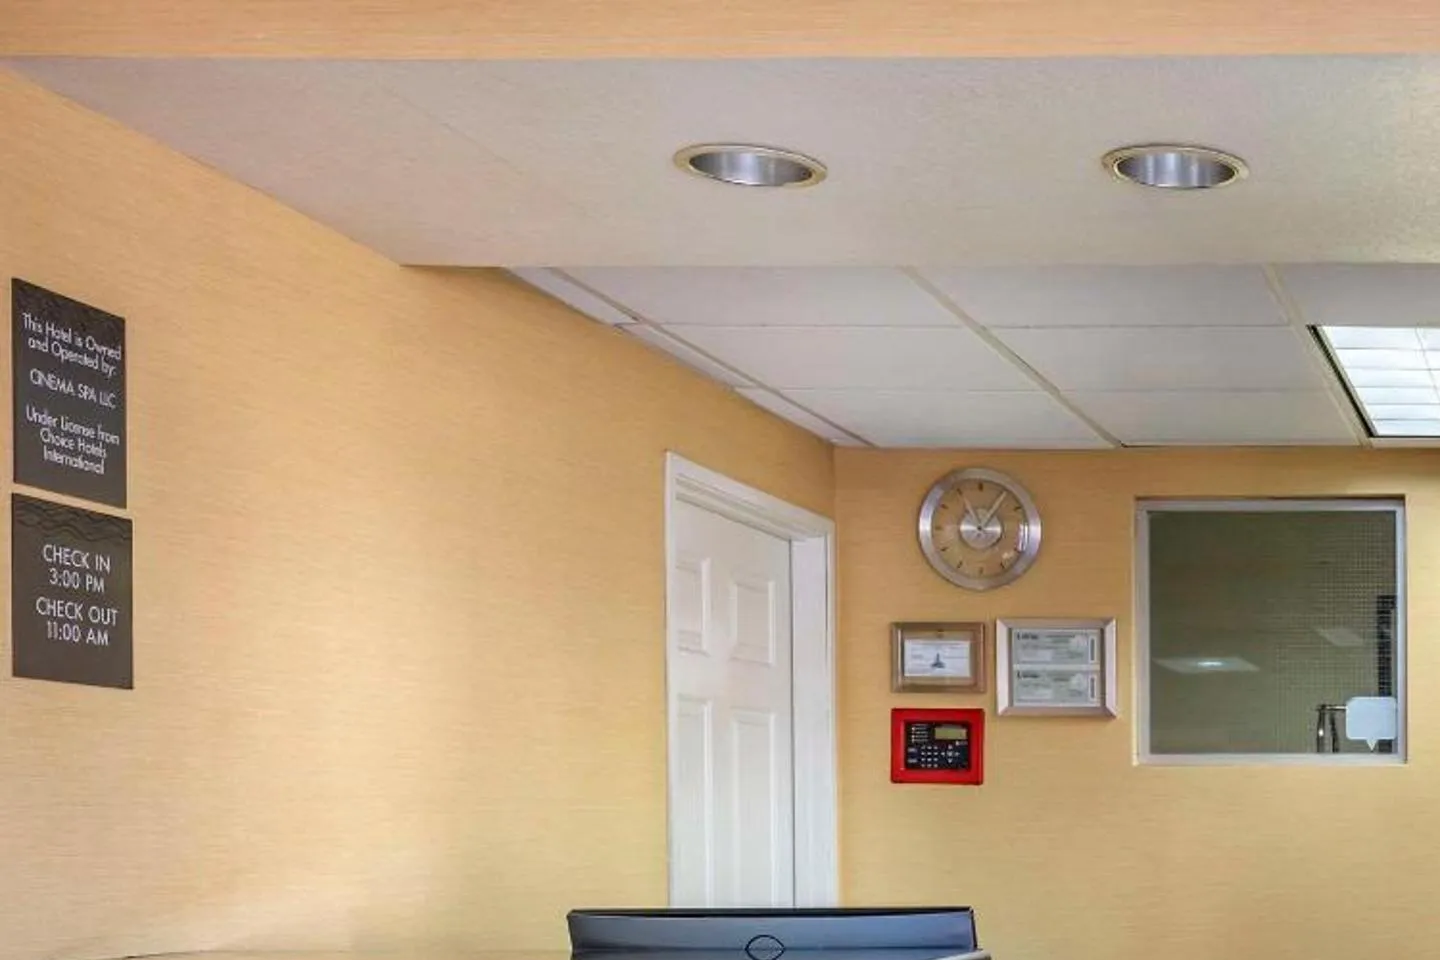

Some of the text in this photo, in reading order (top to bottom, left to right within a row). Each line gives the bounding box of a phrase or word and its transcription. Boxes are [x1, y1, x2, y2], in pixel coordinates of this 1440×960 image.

[22, 312, 122, 360] This Hotel is Owned
[28, 336, 49, 353] and
[51, 341, 99, 370] Operated
[30, 368, 116, 409] CINEMA SPA LLC
[26, 404, 58, 427] Under
[60, 416, 96, 439] License
[40, 428, 107, 458] Choice Hotels
[43, 445, 105, 475] International
[43, 544, 111, 574] CHECK IN
[49, 568, 105, 594] 3:00 PM
[36, 596, 118, 627] CHECK OUT
[47, 620, 109, 646] 11:00 AM
